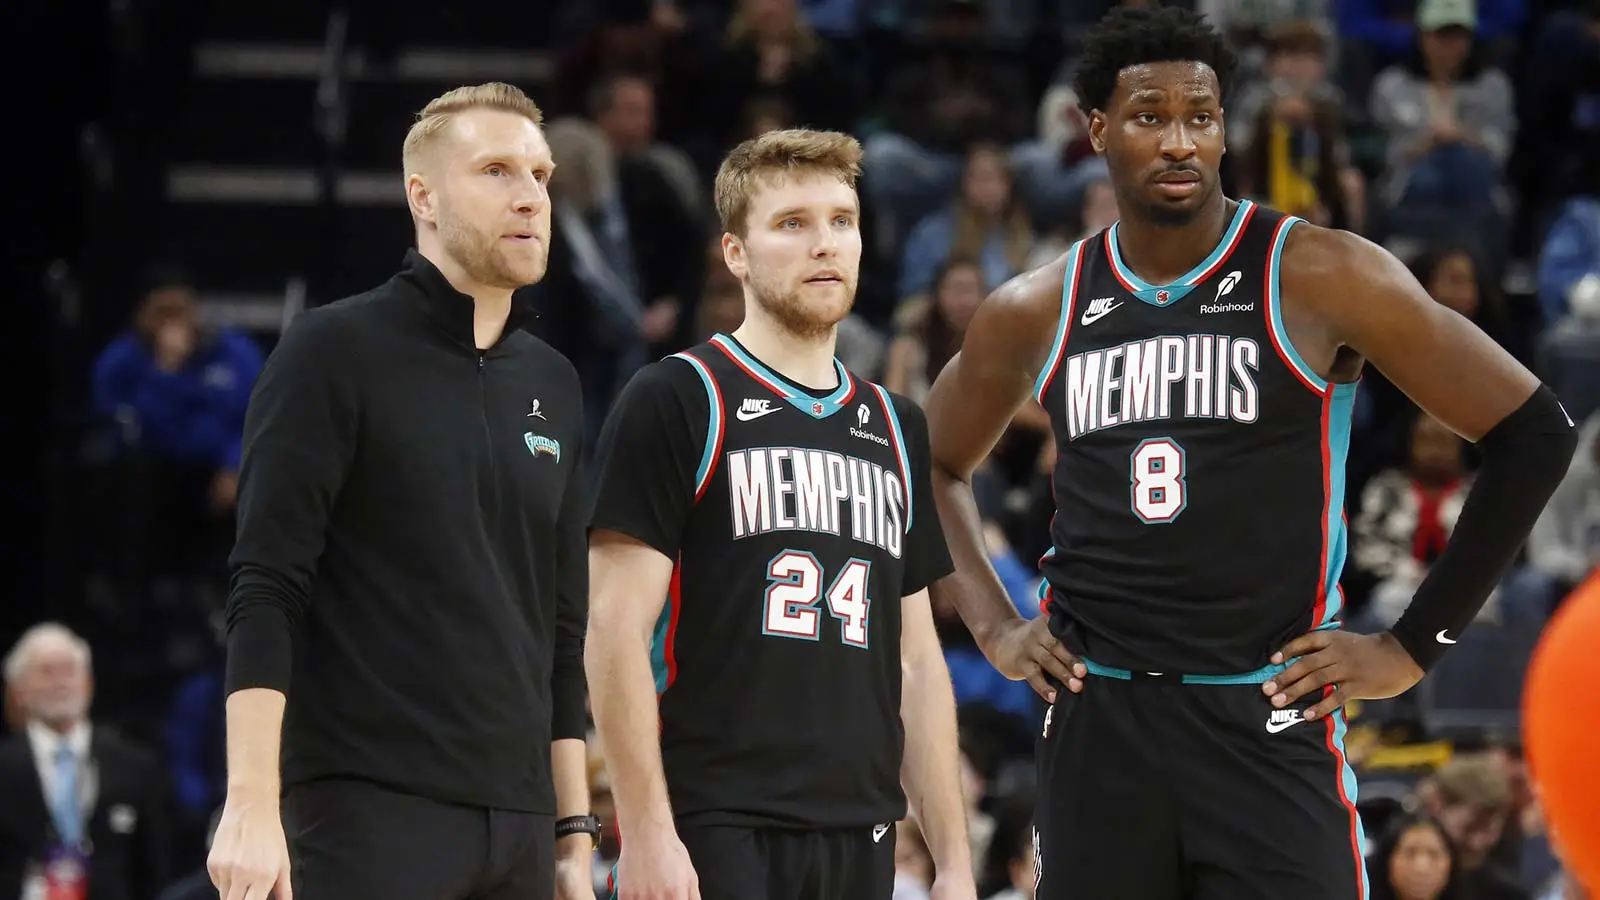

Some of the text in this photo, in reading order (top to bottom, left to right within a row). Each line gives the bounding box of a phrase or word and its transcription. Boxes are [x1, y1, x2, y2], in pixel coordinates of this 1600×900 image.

[1087, 297, 1114, 314] NIKE
[1200, 302, 1254, 314] Robinhood
[1066, 334, 1260, 441] MEMPHIS
[741, 398, 771, 412] NIKE
[849, 427, 889, 447] Robinhood
[1129, 436, 1188, 525] 8
[727, 446, 904, 560] MEMPHIS
[761, 548, 872, 650] 24
[1271, 709, 1299, 723] NIKE
